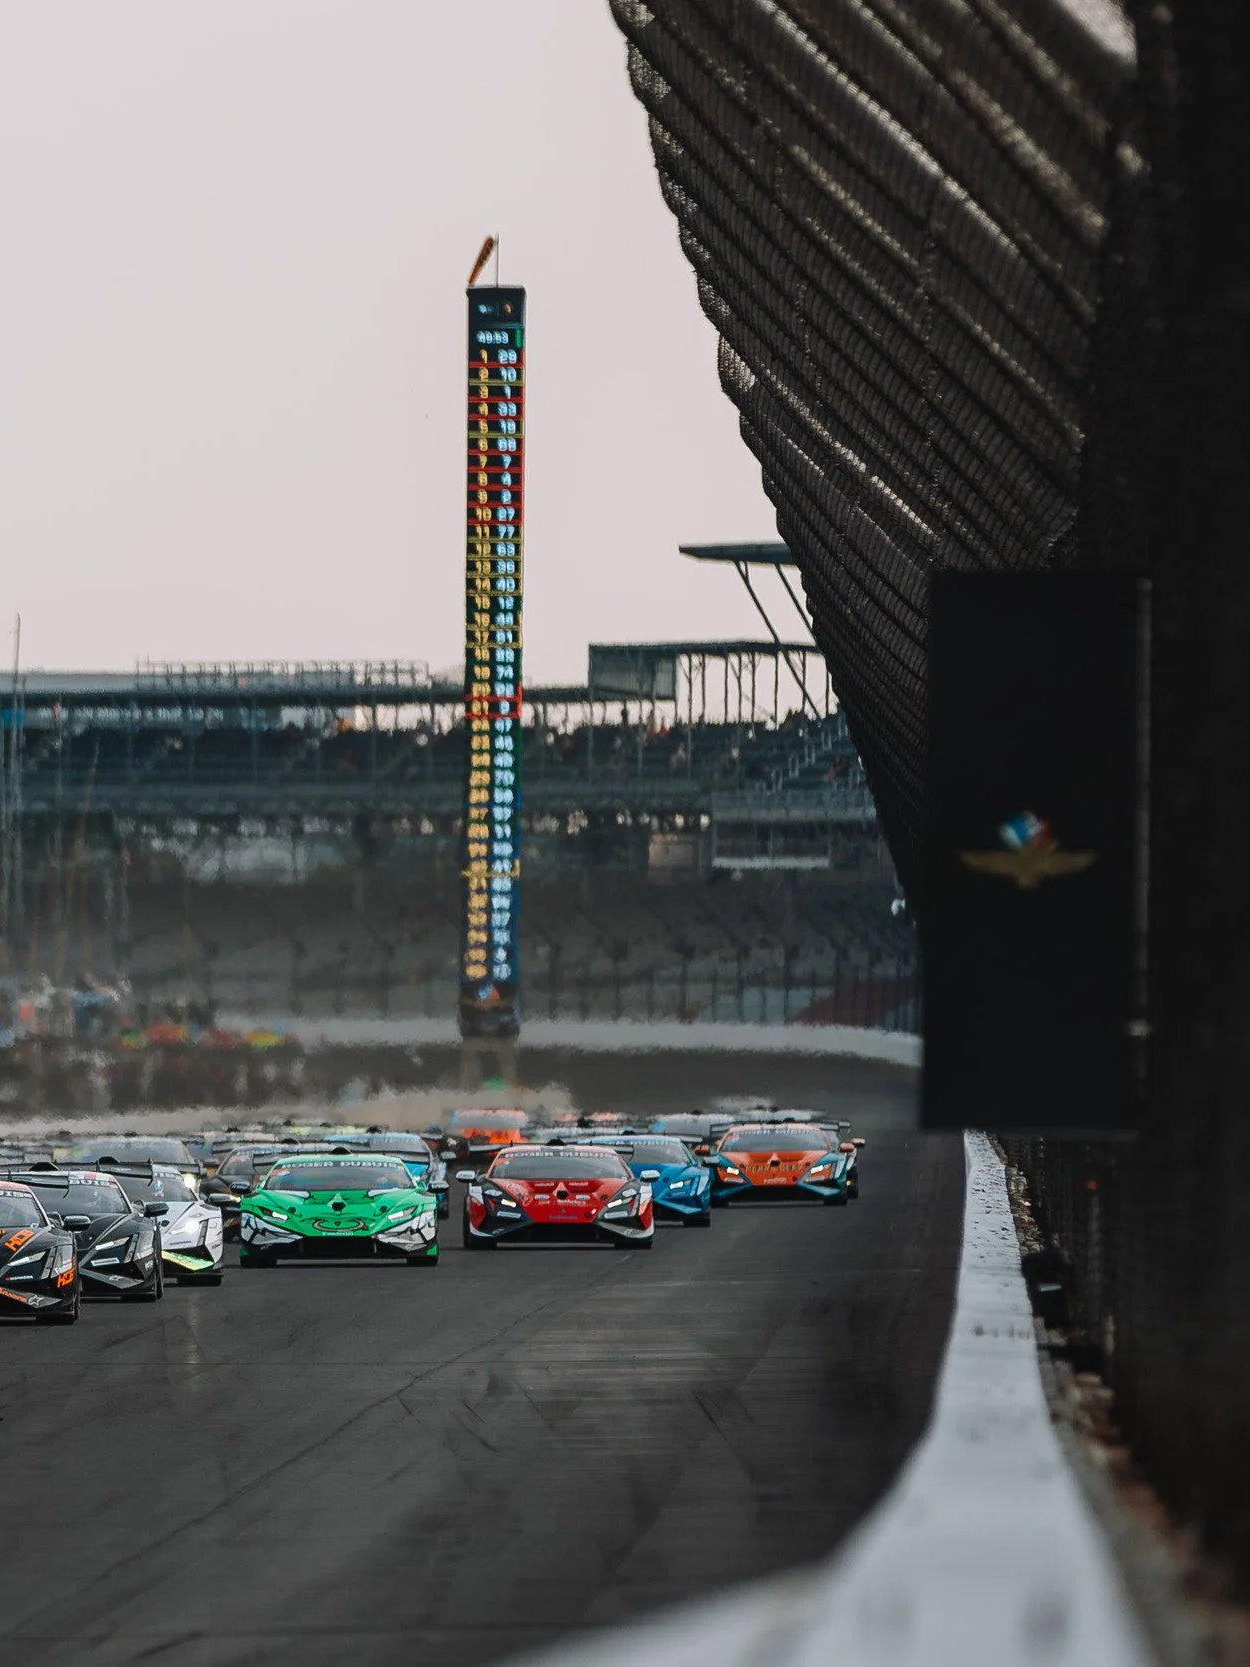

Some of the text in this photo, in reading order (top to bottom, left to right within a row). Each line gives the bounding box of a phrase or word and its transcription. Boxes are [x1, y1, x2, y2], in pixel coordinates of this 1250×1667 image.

[480, 349, 488, 364] 1
[478, 367, 517, 382] 2 10
[479, 454, 488, 469] 7
[476, 506, 492, 521] 10
[476, 523, 490, 539] 11
